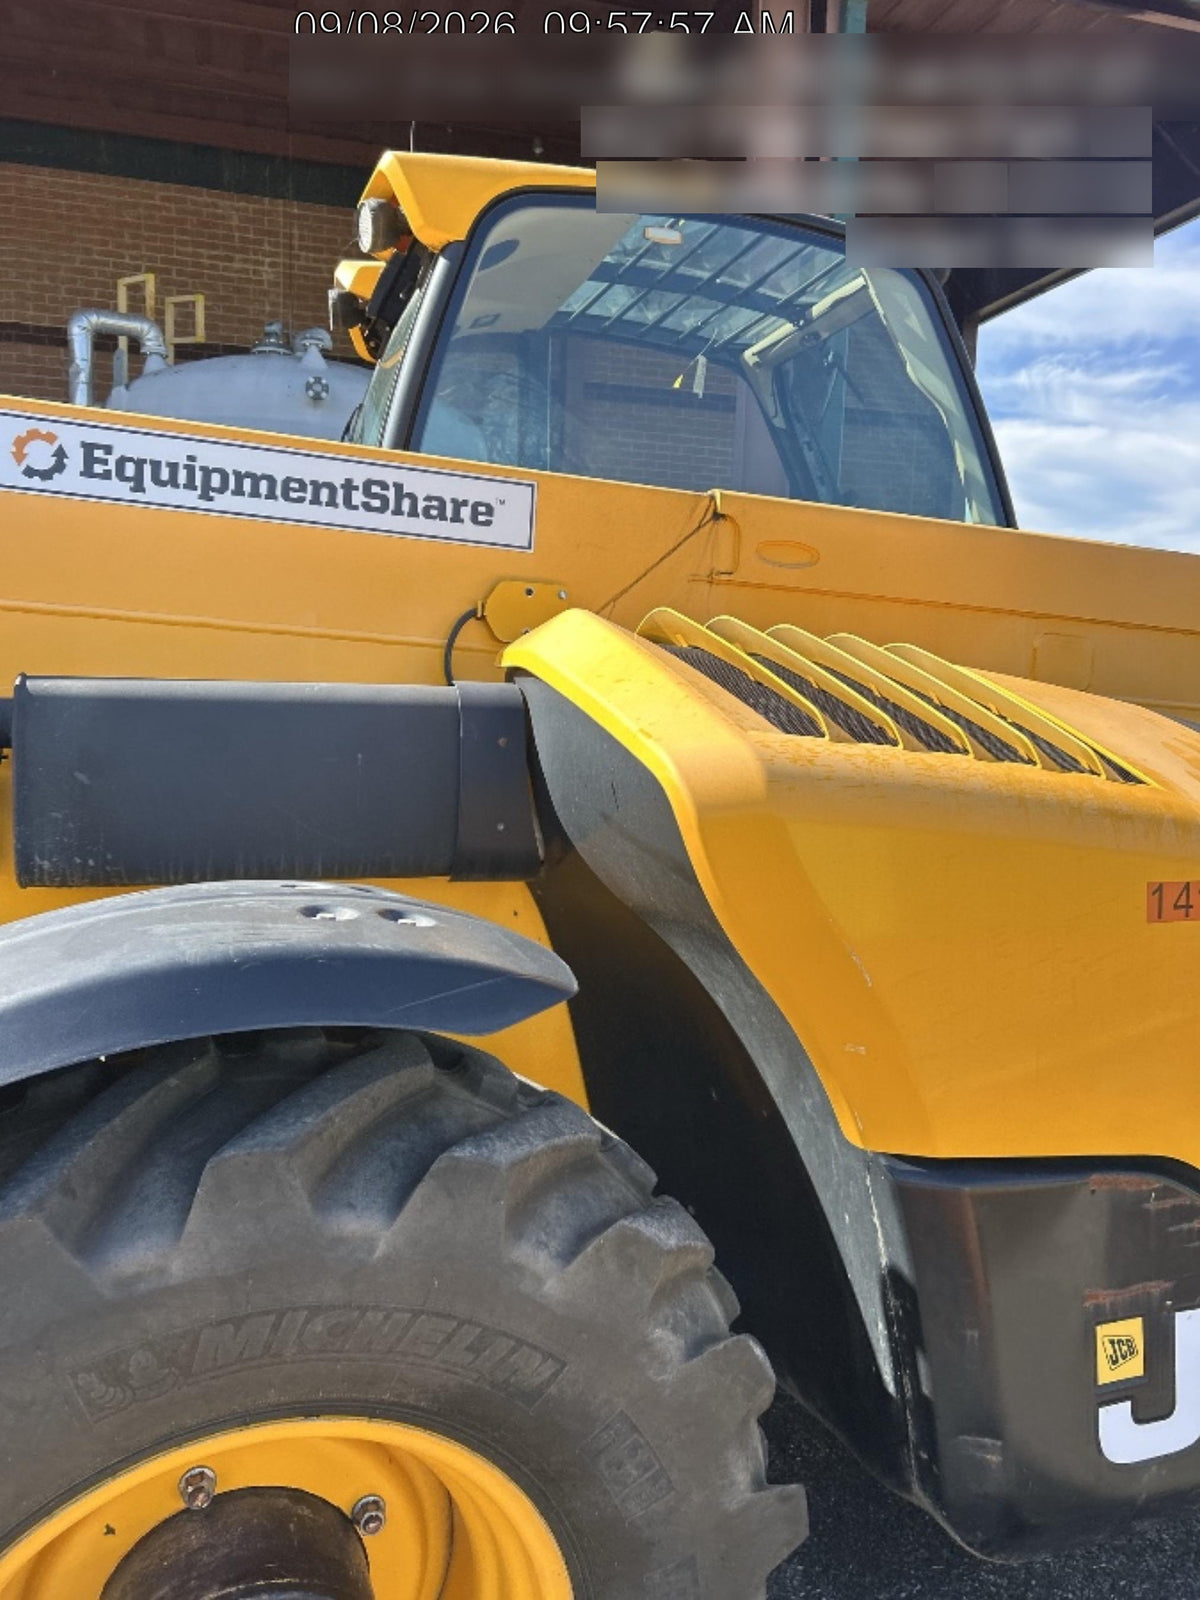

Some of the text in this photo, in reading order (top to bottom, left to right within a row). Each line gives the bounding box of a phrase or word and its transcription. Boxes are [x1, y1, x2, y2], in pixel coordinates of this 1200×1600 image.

[80, 441, 495, 527] EquipmentShare
[1152, 882, 1200, 919] 14
[193, 1308, 564, 1391] MICHELIN
[1108, 1337, 1137, 1366] JCB
